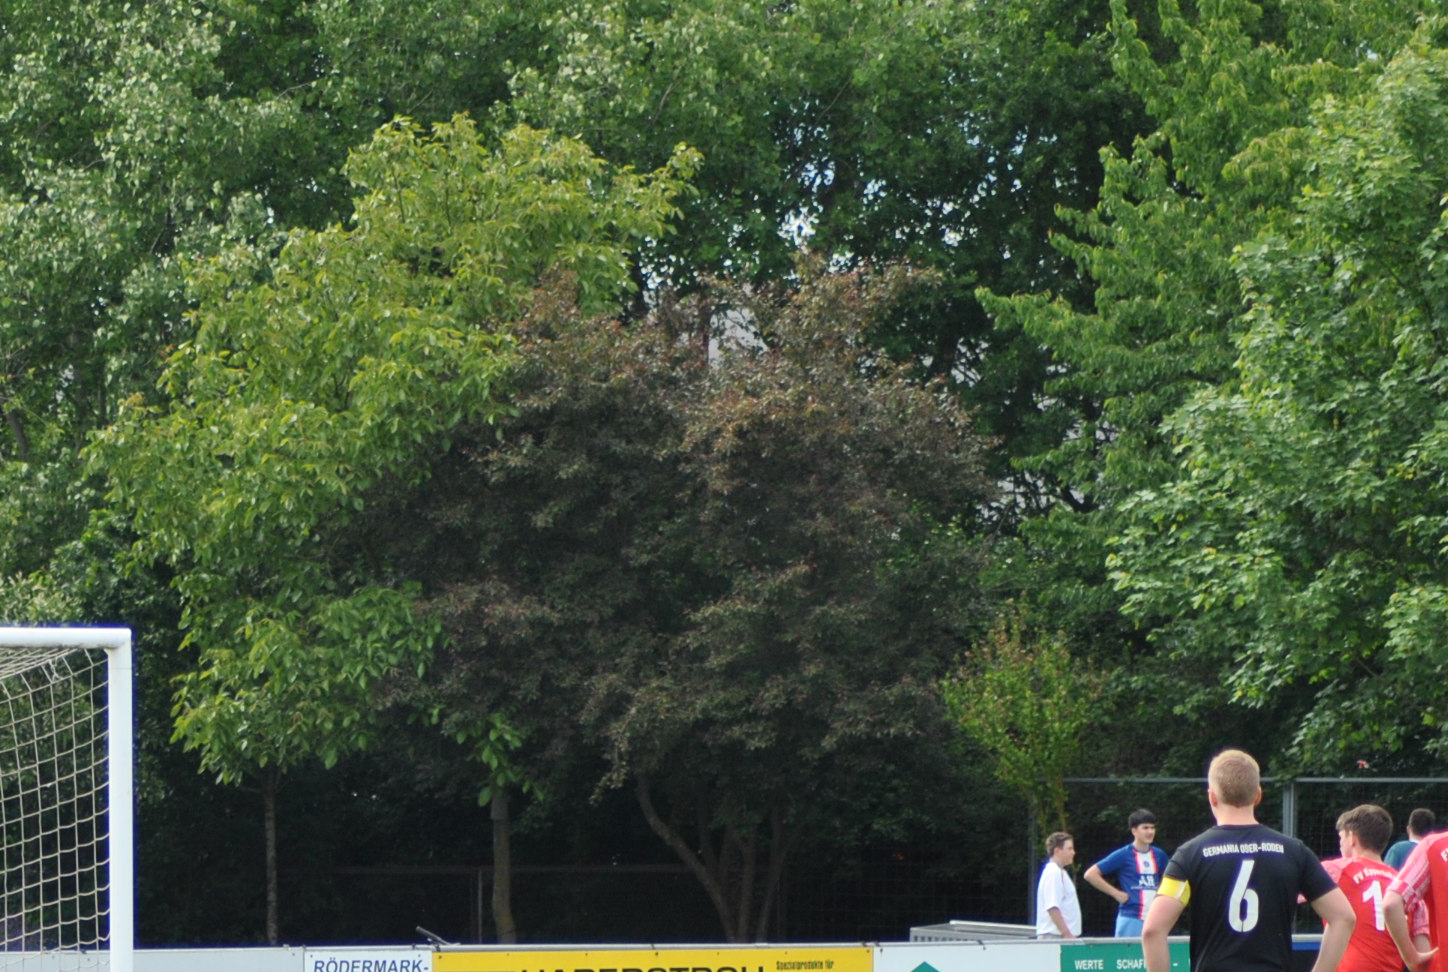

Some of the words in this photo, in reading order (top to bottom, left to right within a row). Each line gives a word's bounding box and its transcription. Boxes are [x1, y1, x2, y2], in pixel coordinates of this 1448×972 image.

[1203, 844, 1239, 858] GERMANIA
[1240, 842, 1284, 855] OBER-RODEN
[1229, 859, 1259, 933] 6
[1074, 960, 1104, 970] WERTE
